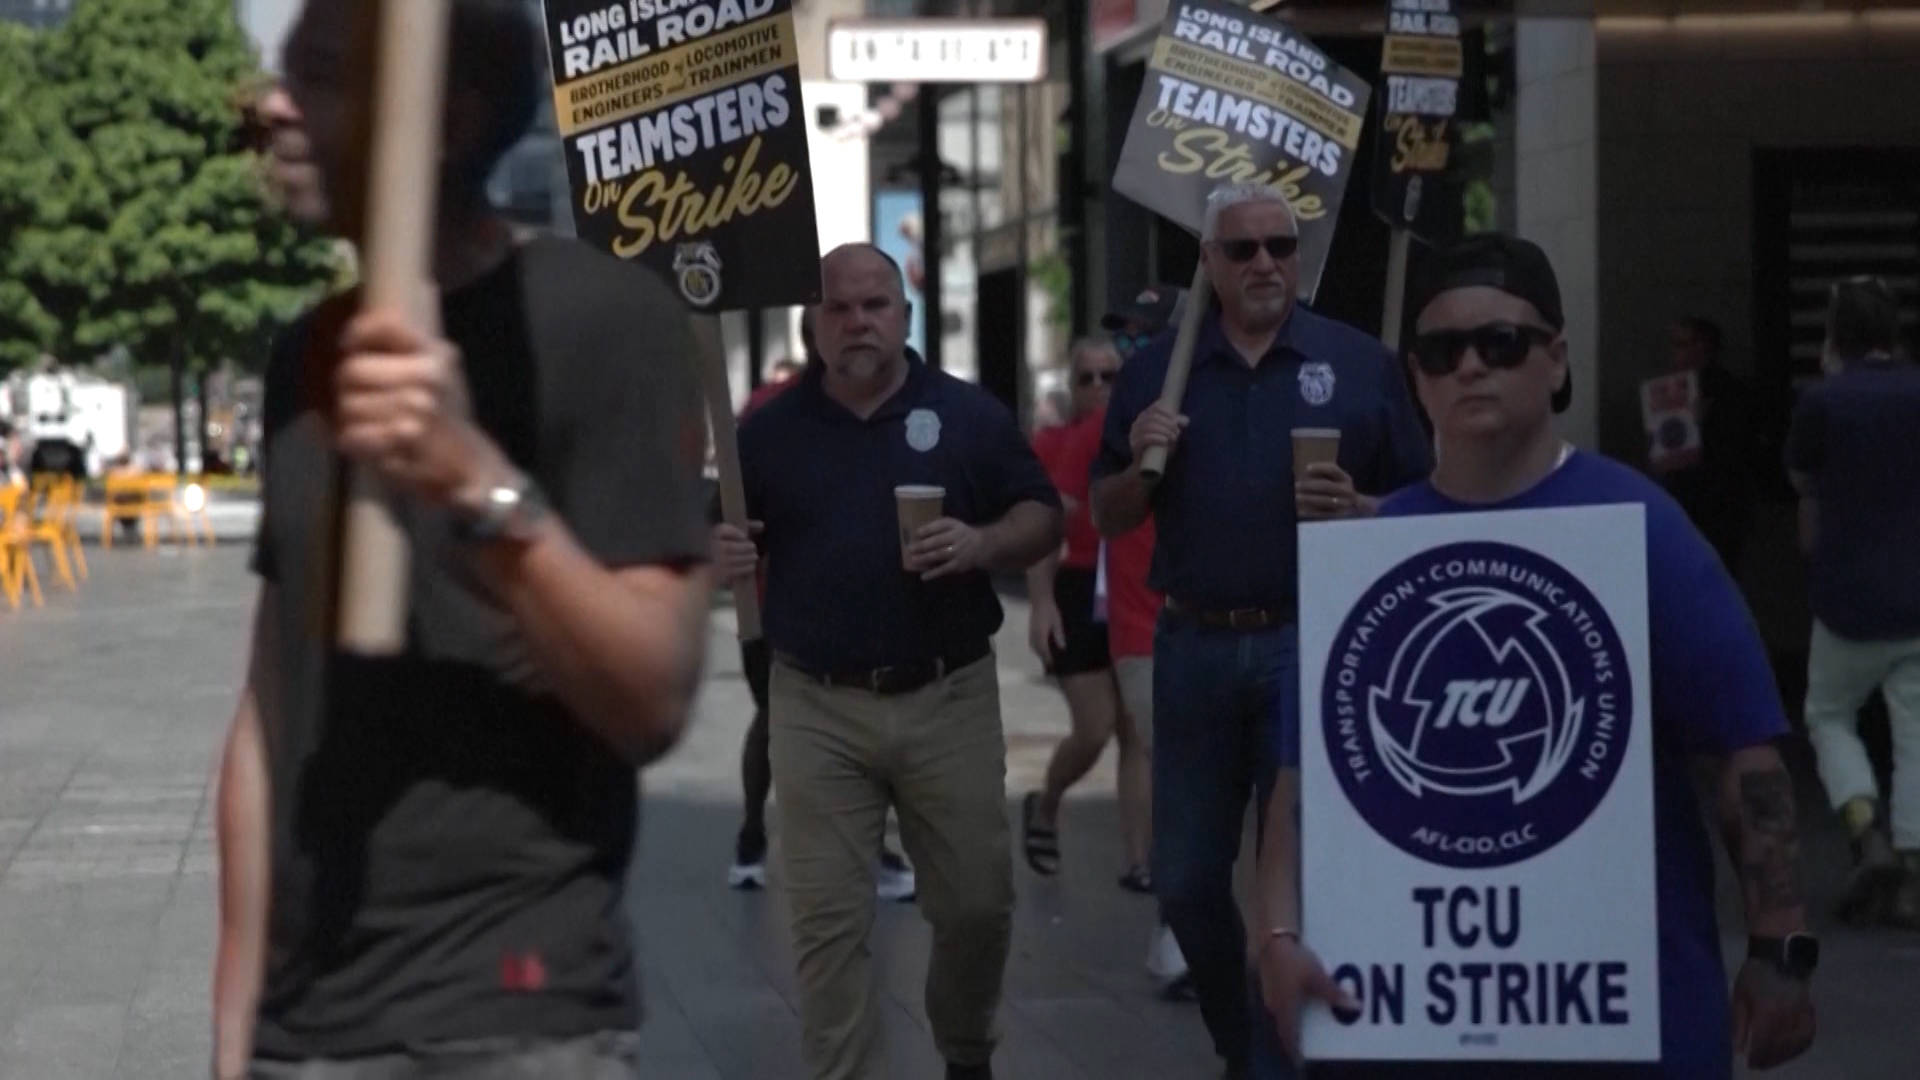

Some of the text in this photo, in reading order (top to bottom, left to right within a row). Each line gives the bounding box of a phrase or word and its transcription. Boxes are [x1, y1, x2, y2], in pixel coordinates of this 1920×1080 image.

[560, 3, 626, 46] LONG
[563, 0, 774, 78] RAIL ROAD
[570, 60, 670, 103] BROTHERHOOD
[686, 24, 779, 67] LOCOMOTIVE
[1174, 19, 1256, 61] RAIL
[1264, 47, 1355, 107] ROAD
[1180, 5, 1326, 70] LONG ISLAND
[572, 84, 664, 124] ENGINEERS
[689, 45, 782, 87] TRAINMEN
[576, 74, 790, 184] TEAMSTERS
[1145, 108, 1326, 220] On Strike
[1158, 77, 1342, 177] TEAMSTERS
[584, 136, 798, 259] On Strike
[1336, 559, 1616, 783] TRANSPORTATION COMMUNICATIONS UNION
[1433, 678, 1532, 728] TCU
[1412, 885, 1521, 949] TCU
[1331, 961, 1629, 1026] ON STRIKE
